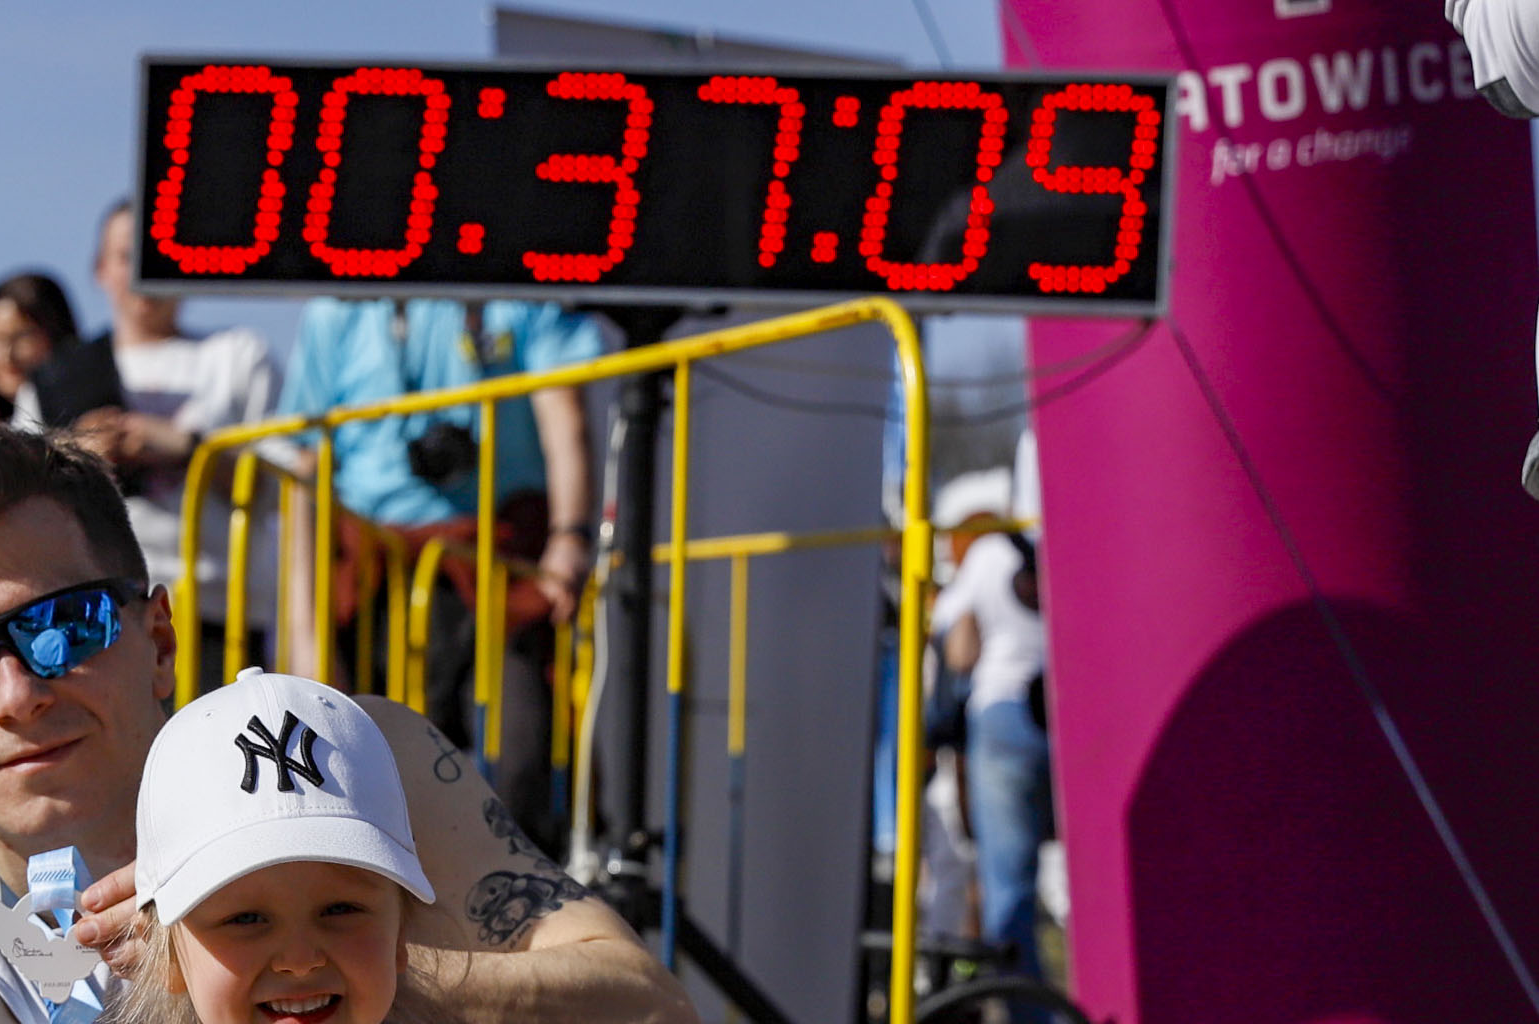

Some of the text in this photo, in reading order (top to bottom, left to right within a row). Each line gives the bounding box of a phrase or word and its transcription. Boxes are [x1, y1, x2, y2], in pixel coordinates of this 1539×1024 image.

[1177, 40, 1477, 132] ATOWICE
[151, 65, 1160, 293] 00:37:09
[1211, 136, 1262, 187] for
[1266, 137, 1293, 171] a
[234, 710, 324, 793] NY
